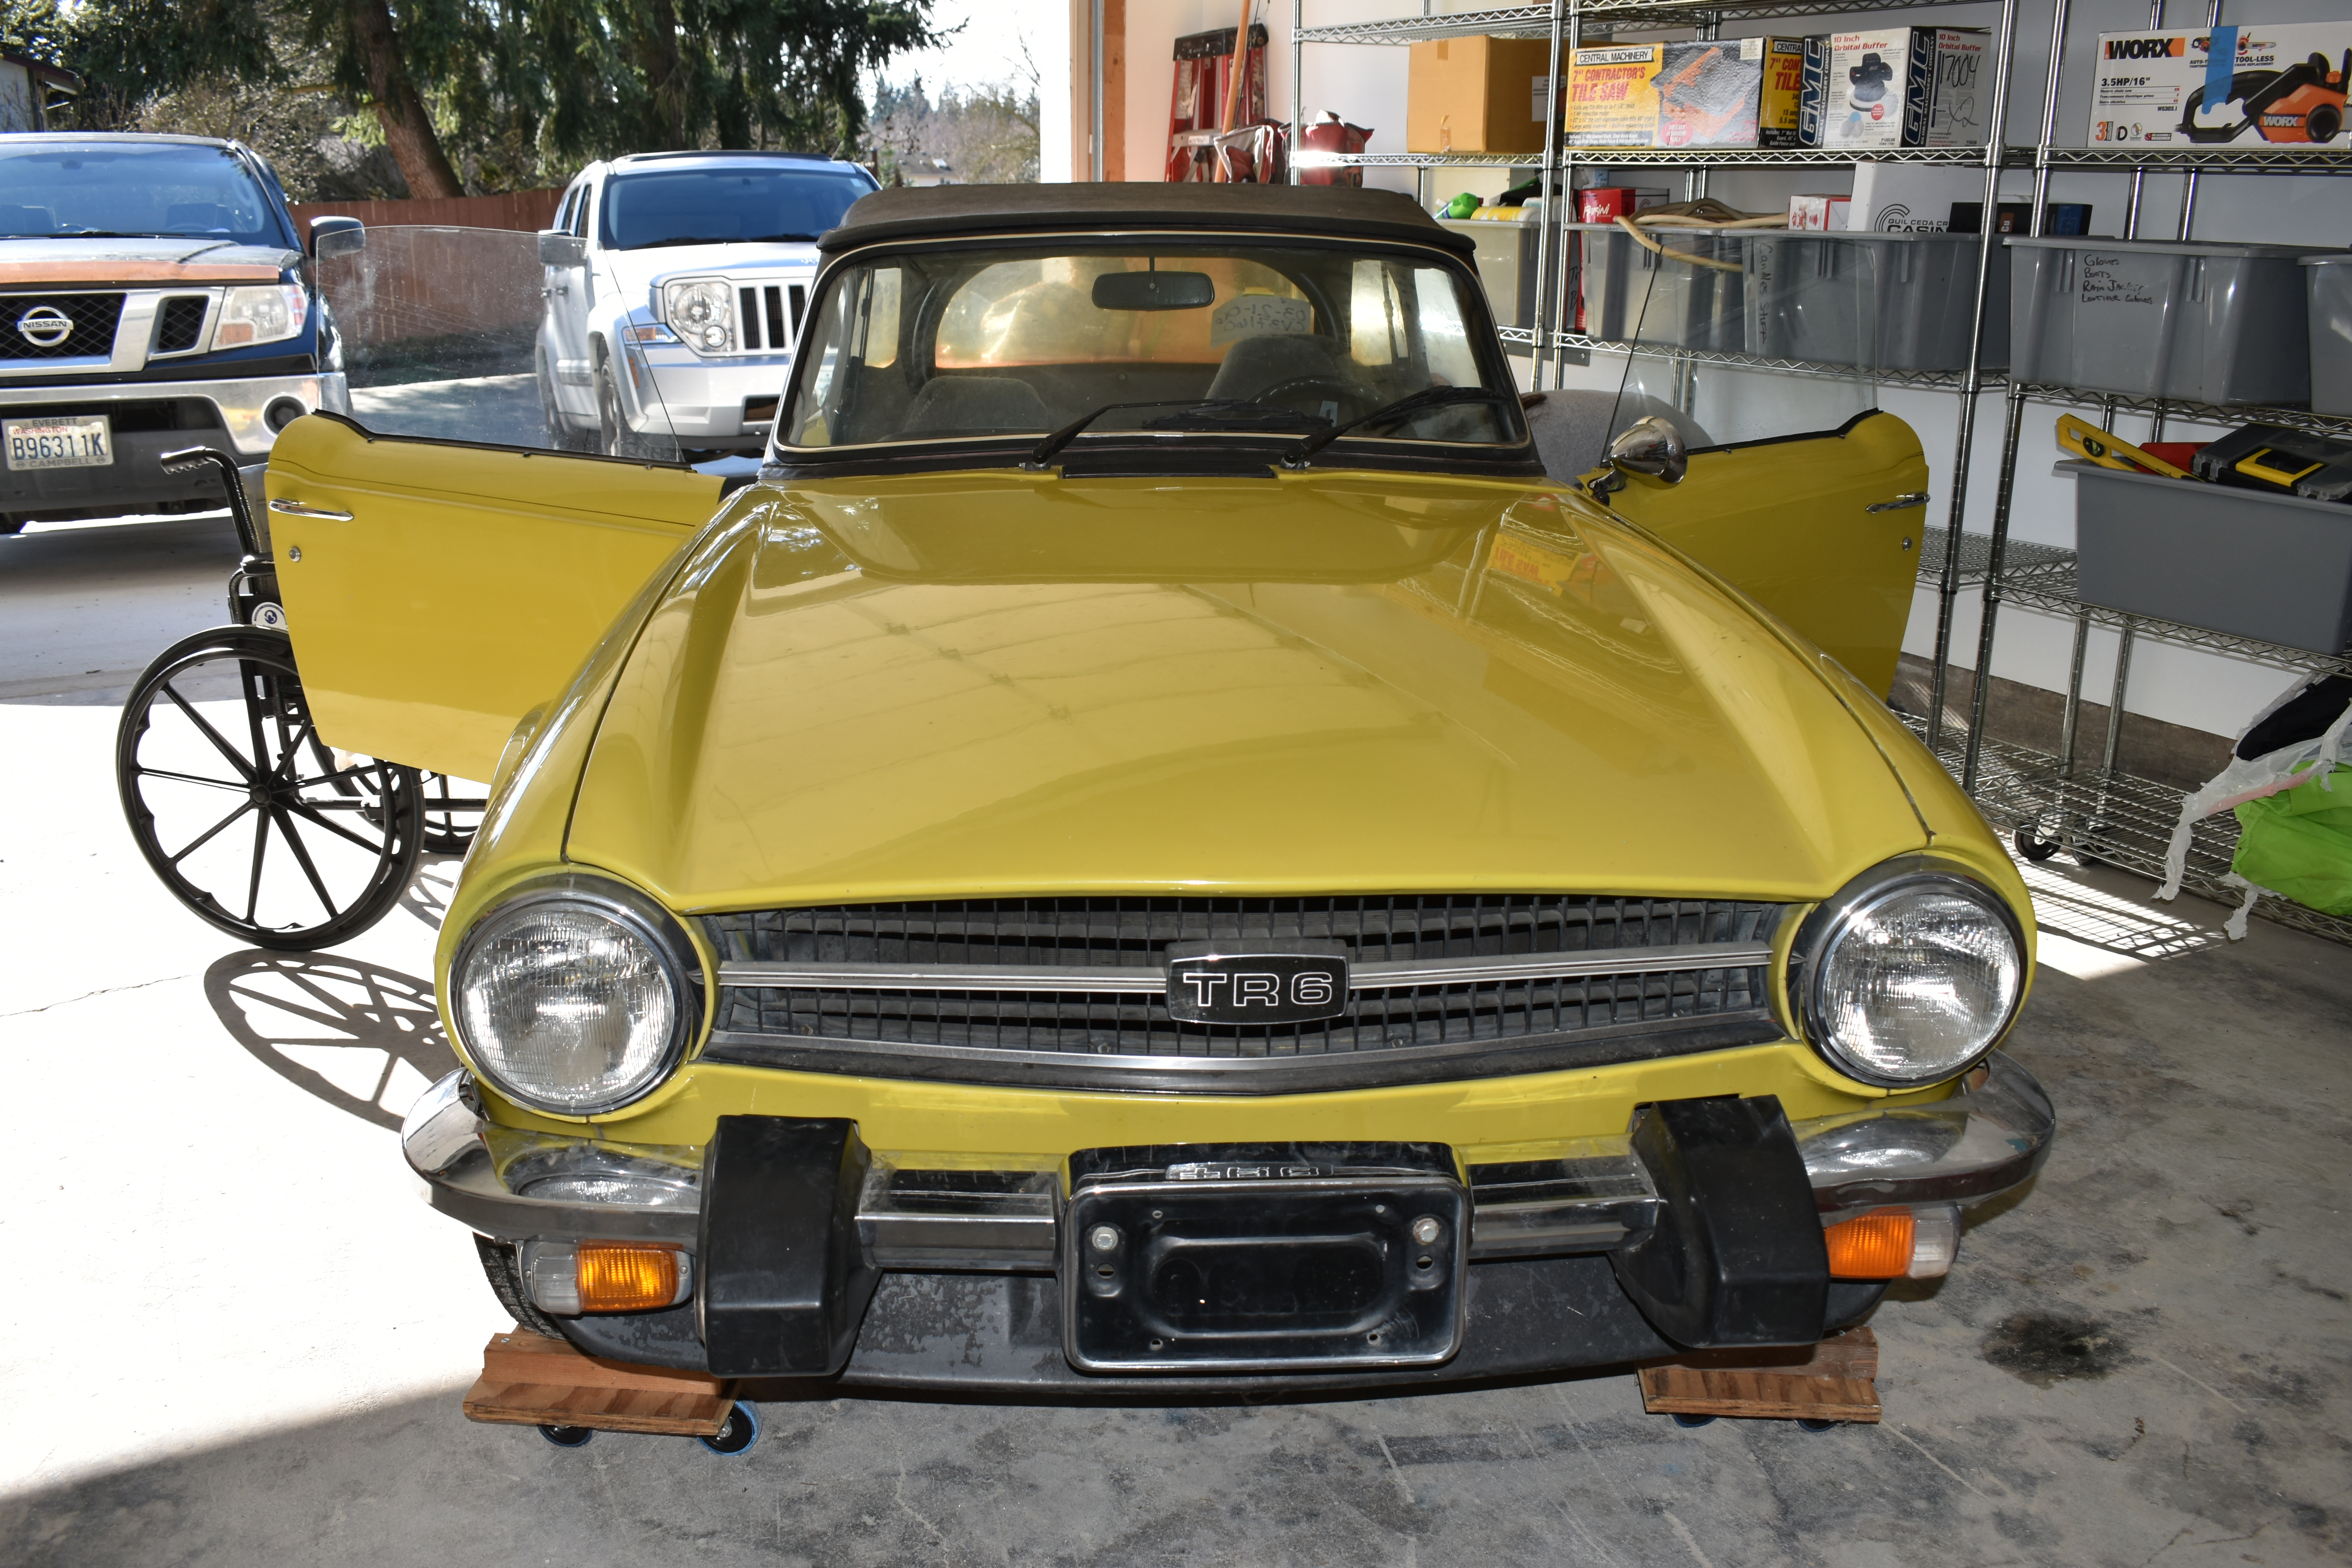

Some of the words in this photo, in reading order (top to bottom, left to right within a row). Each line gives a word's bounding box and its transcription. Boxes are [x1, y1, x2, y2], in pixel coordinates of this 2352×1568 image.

[1580, 54, 1609, 63] CENTRAL
[1611, 51, 1649, 61] MACHINERY
[2109, 38, 2174, 60] WORX
[1769, 57, 1780, 69] 7"
[1940, 53, 1980, 89] 17004
[1573, 69, 1584, 82] 7"
[1584, 66, 1646, 82] CONTRACTOR'S
[1775, 72, 1800, 91] TILE
[2101, 77, 2151, 87] 3.5HP/16"
[1572, 83, 1598, 102] TILE
[1599, 81, 1630, 101] SAW
[1799, 38, 1825, 146] GMC
[1904, 31, 1929, 145] GMC
[2095, 121, 2107, 141] 3
[2263, 116, 2299, 127] WORX
[13, 426, 68, 435] WASHINGTON
[32, 417, 78, 427] EVERETT
[13, 433, 104, 460] B96311K
[29, 458, 93, 468] CAMPBELL
[1183, 972, 1333, 1007] TR6
